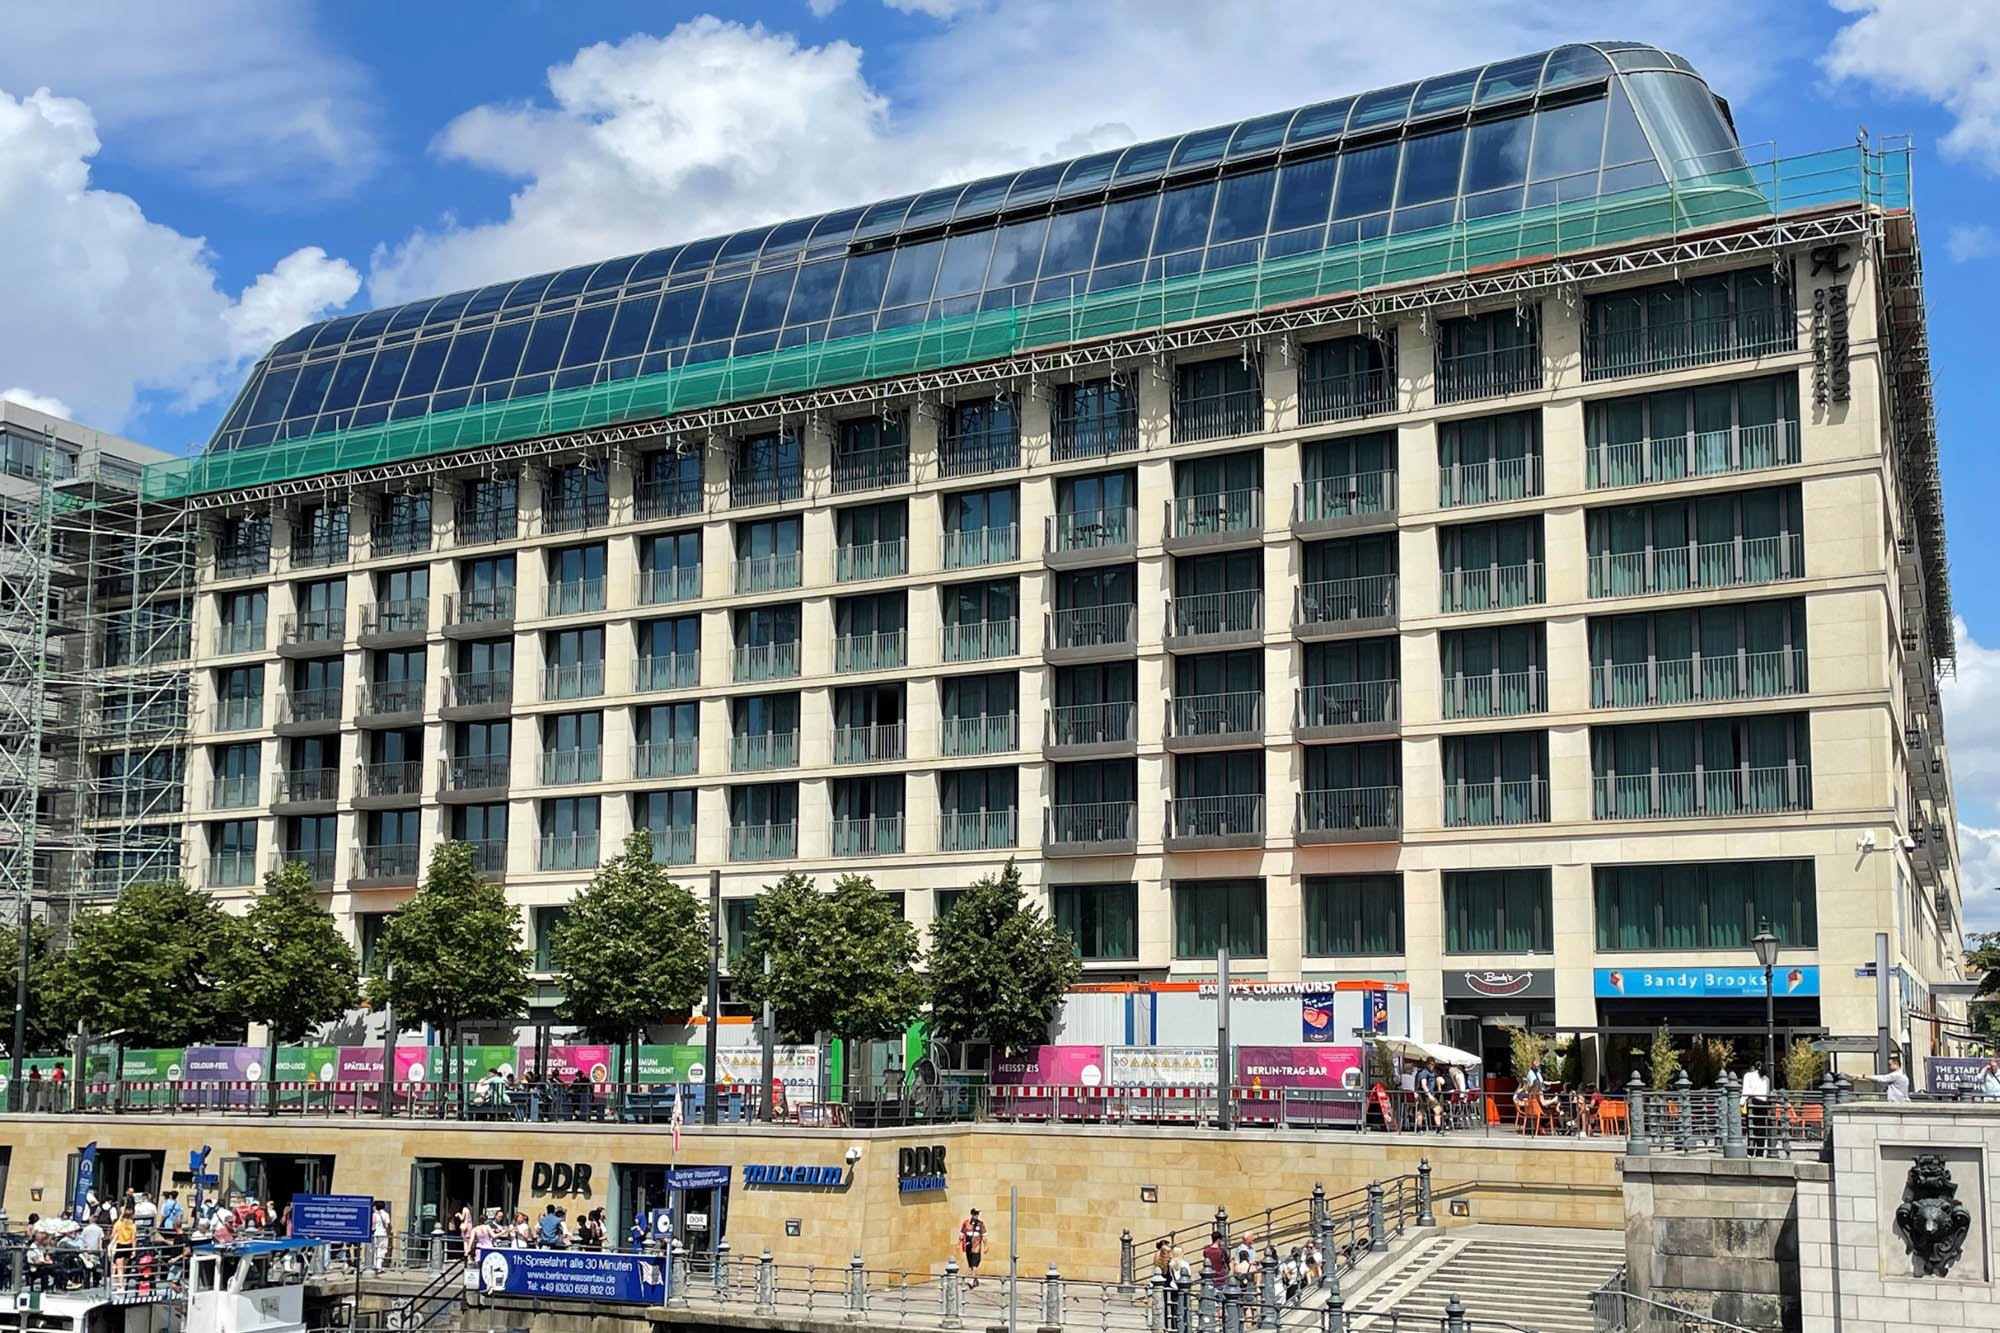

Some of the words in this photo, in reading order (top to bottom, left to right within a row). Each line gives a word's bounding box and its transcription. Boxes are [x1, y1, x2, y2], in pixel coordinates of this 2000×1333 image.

[1814, 288, 1827, 408] COLLECTION
[1828, 283, 1851, 402] RADISSON
[1253, 981, 1337, 995] CURRYWURST
[1643, 974, 1698, 988] Bandy
[1704, 973, 1768, 986] Brooks
[998, 1063, 1025, 1072] HEISS?
[1026, 1063, 1040, 1073] EIS
[1935, 1065, 1952, 1074] THE
[1953, 1066, 1980, 1074] START
[899, 1145, 948, 1177] DDR
[531, 1161, 592, 1196] DDR
[743, 1164, 844, 1185] museum
[900, 1175, 948, 1193] museum
[512, 1254, 568, 1269] 1h-Spreefahrt
[569, 1257, 584, 1269] alle
[585, 1258, 596, 1269] 30
[598, 1258, 633, 1271] Minuten
[540, 1283, 554, 1292] +49
[590, 1286, 604, 1295] 802
[605, 1287, 616, 1296] 03
